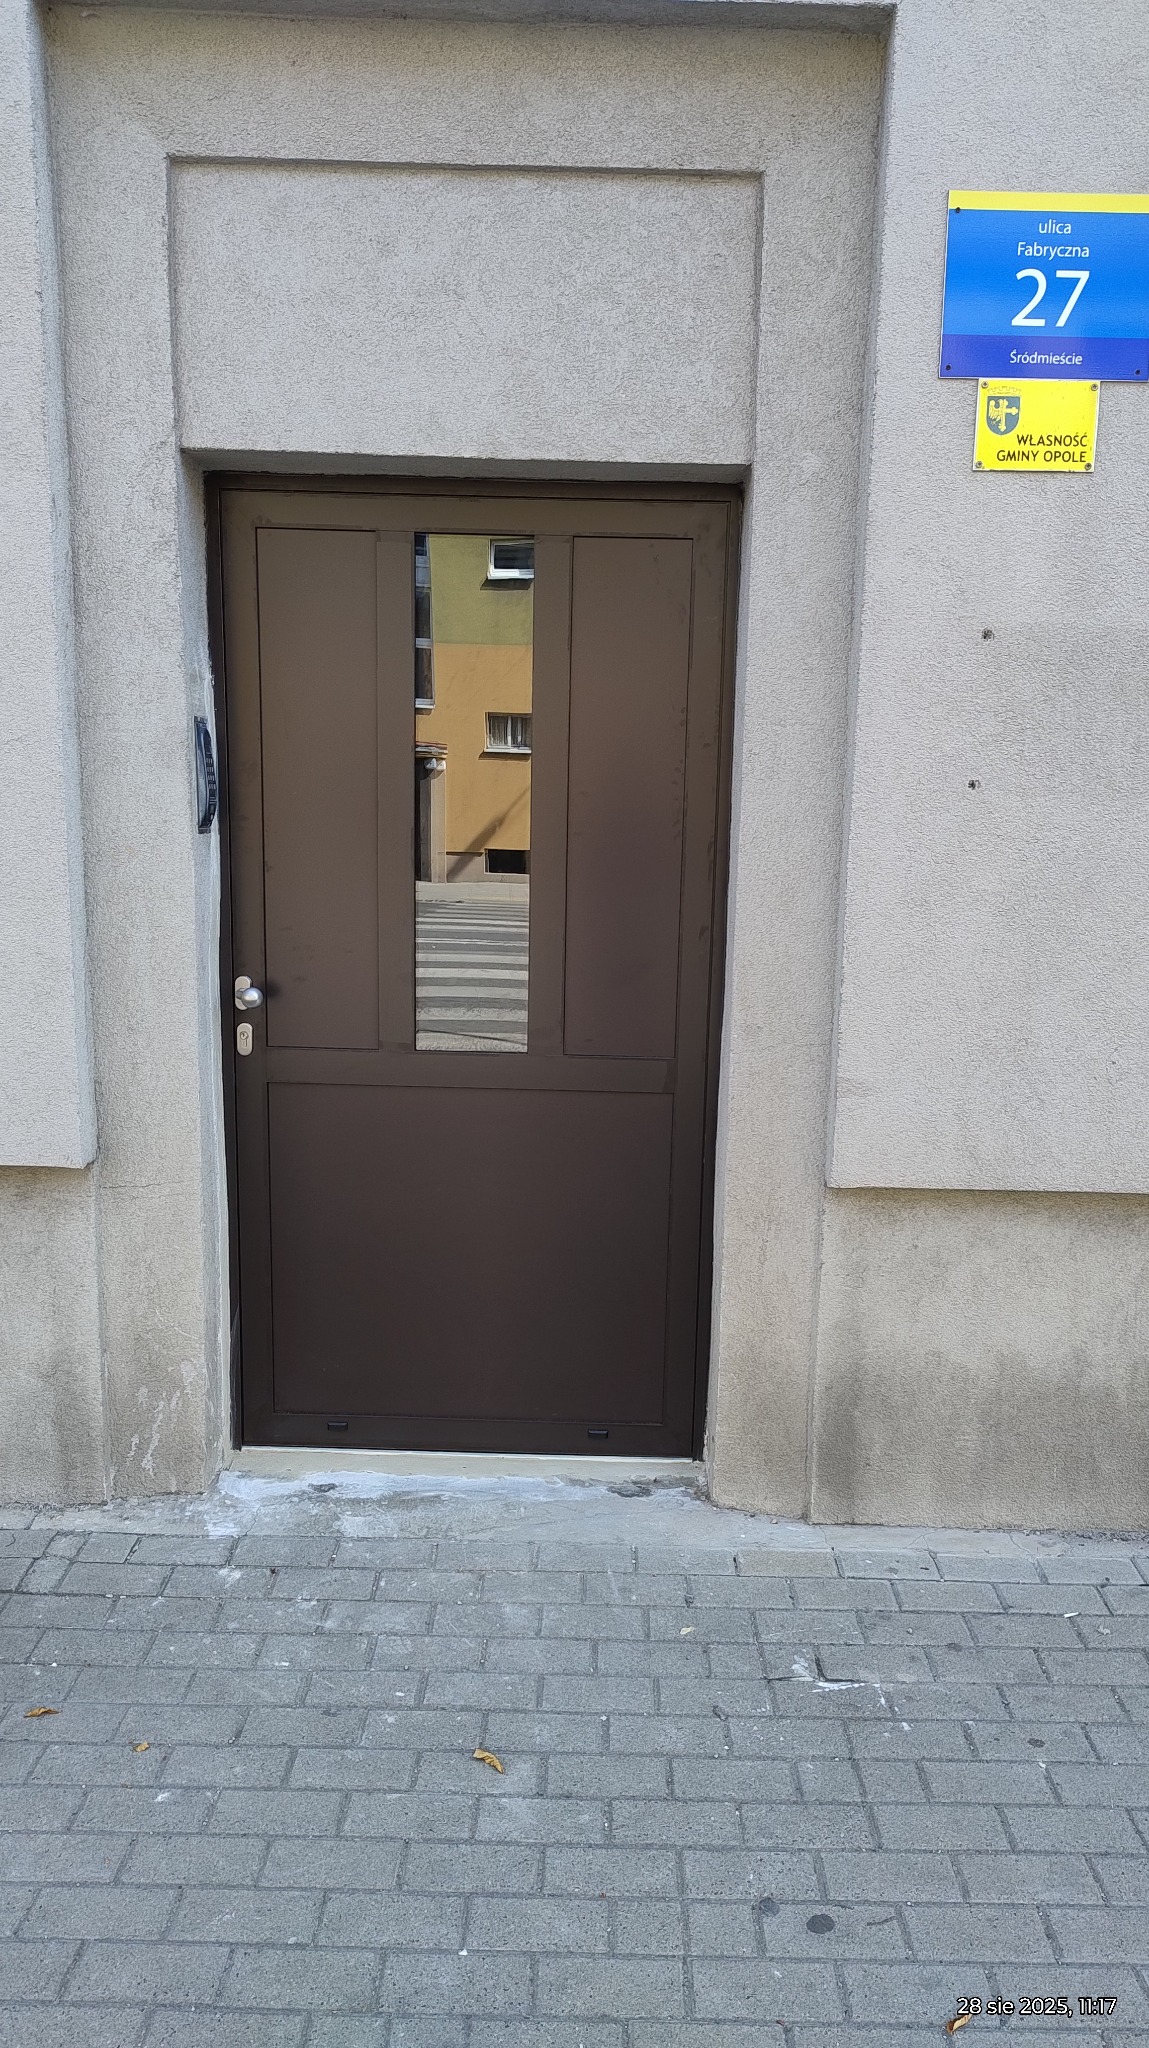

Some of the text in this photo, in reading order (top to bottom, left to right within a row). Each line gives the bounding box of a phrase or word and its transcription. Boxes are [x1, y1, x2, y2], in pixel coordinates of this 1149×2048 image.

[1038, 218, 1072, 234] ulica
[1017, 242, 1090, 260] Fabryczna
[1011, 268, 1090, 328] 27
[1009, 349, 1083, 365] Śródmieście
[1016, 432, 1088, 447] WŁASNOŚĆ
[996, 450, 1087, 463] GMINY OPOLE
